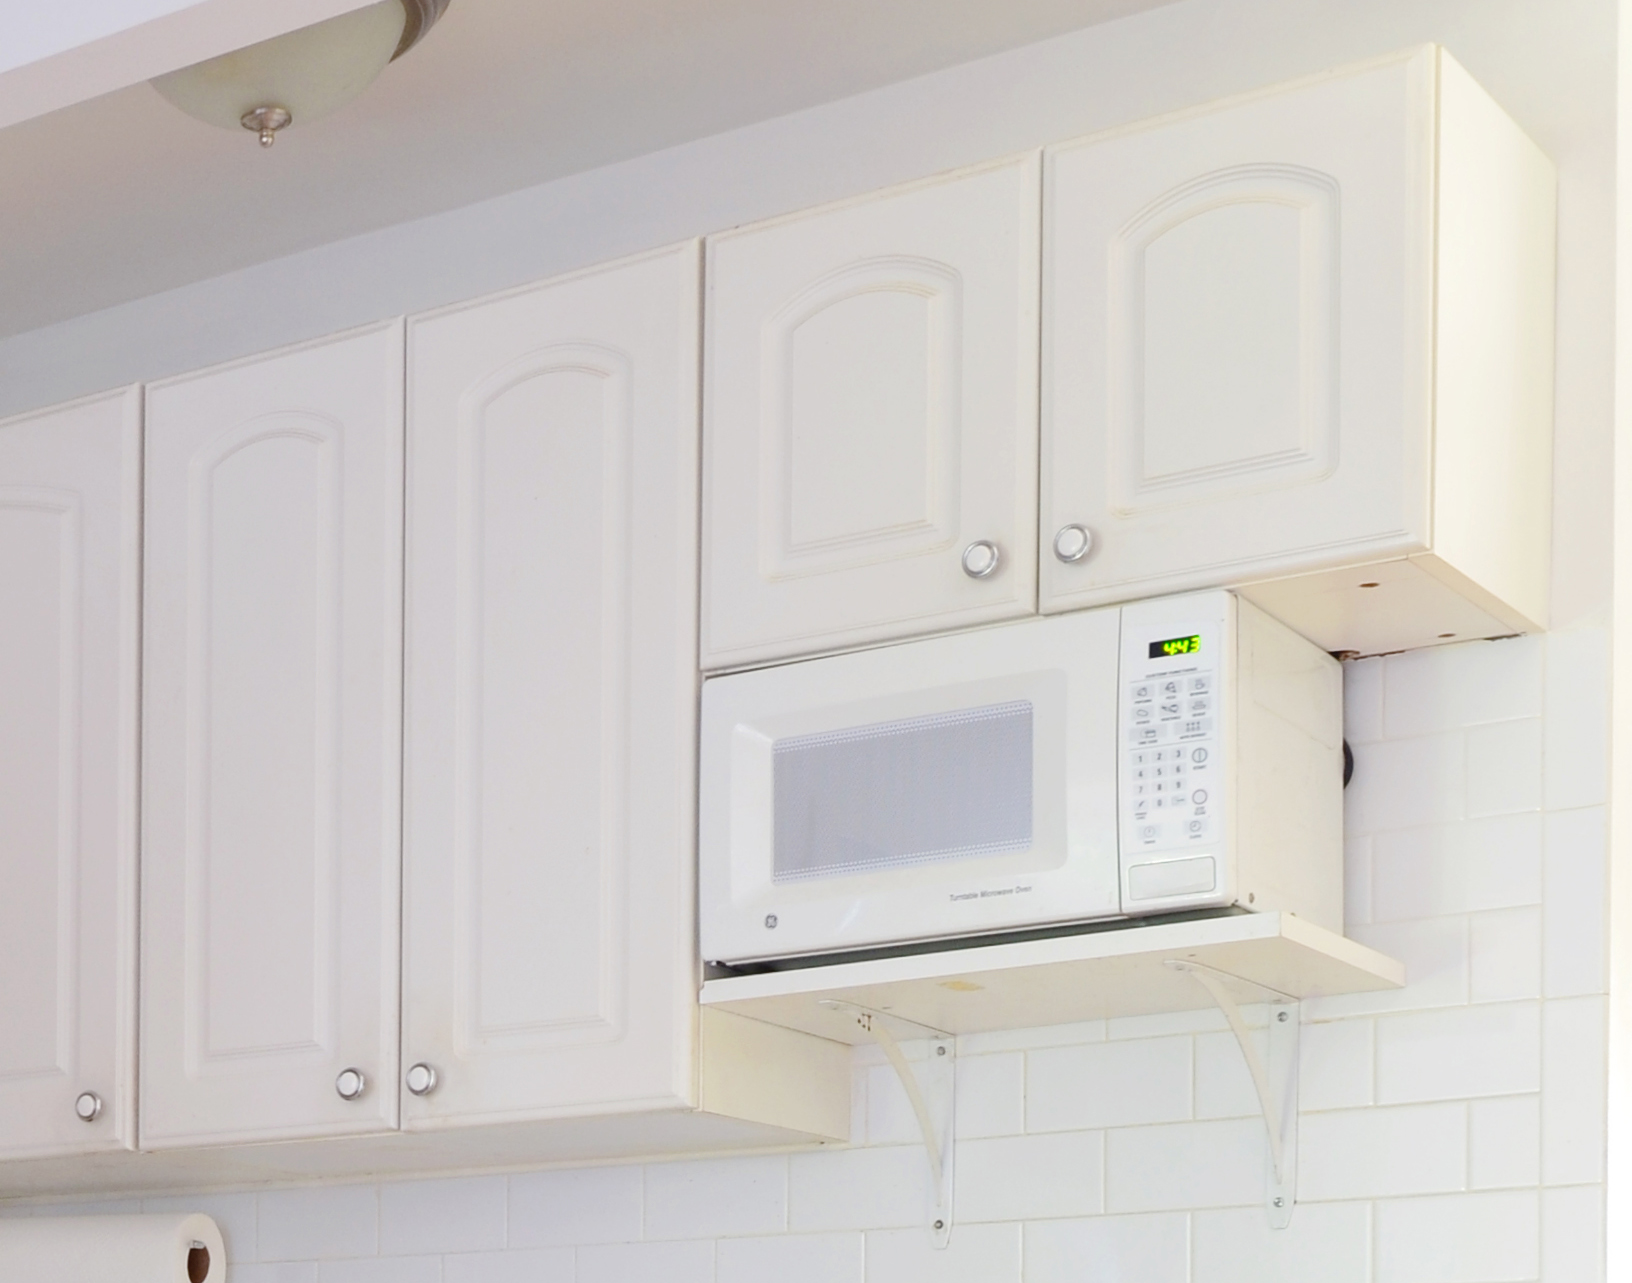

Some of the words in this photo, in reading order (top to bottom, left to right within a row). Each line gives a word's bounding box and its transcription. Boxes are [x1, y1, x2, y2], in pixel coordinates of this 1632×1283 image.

[1163, 637, 1201, 656] 4:43
[980, 888, 1014, 898] Microwave
[1015, 885, 1032, 894] Oven
